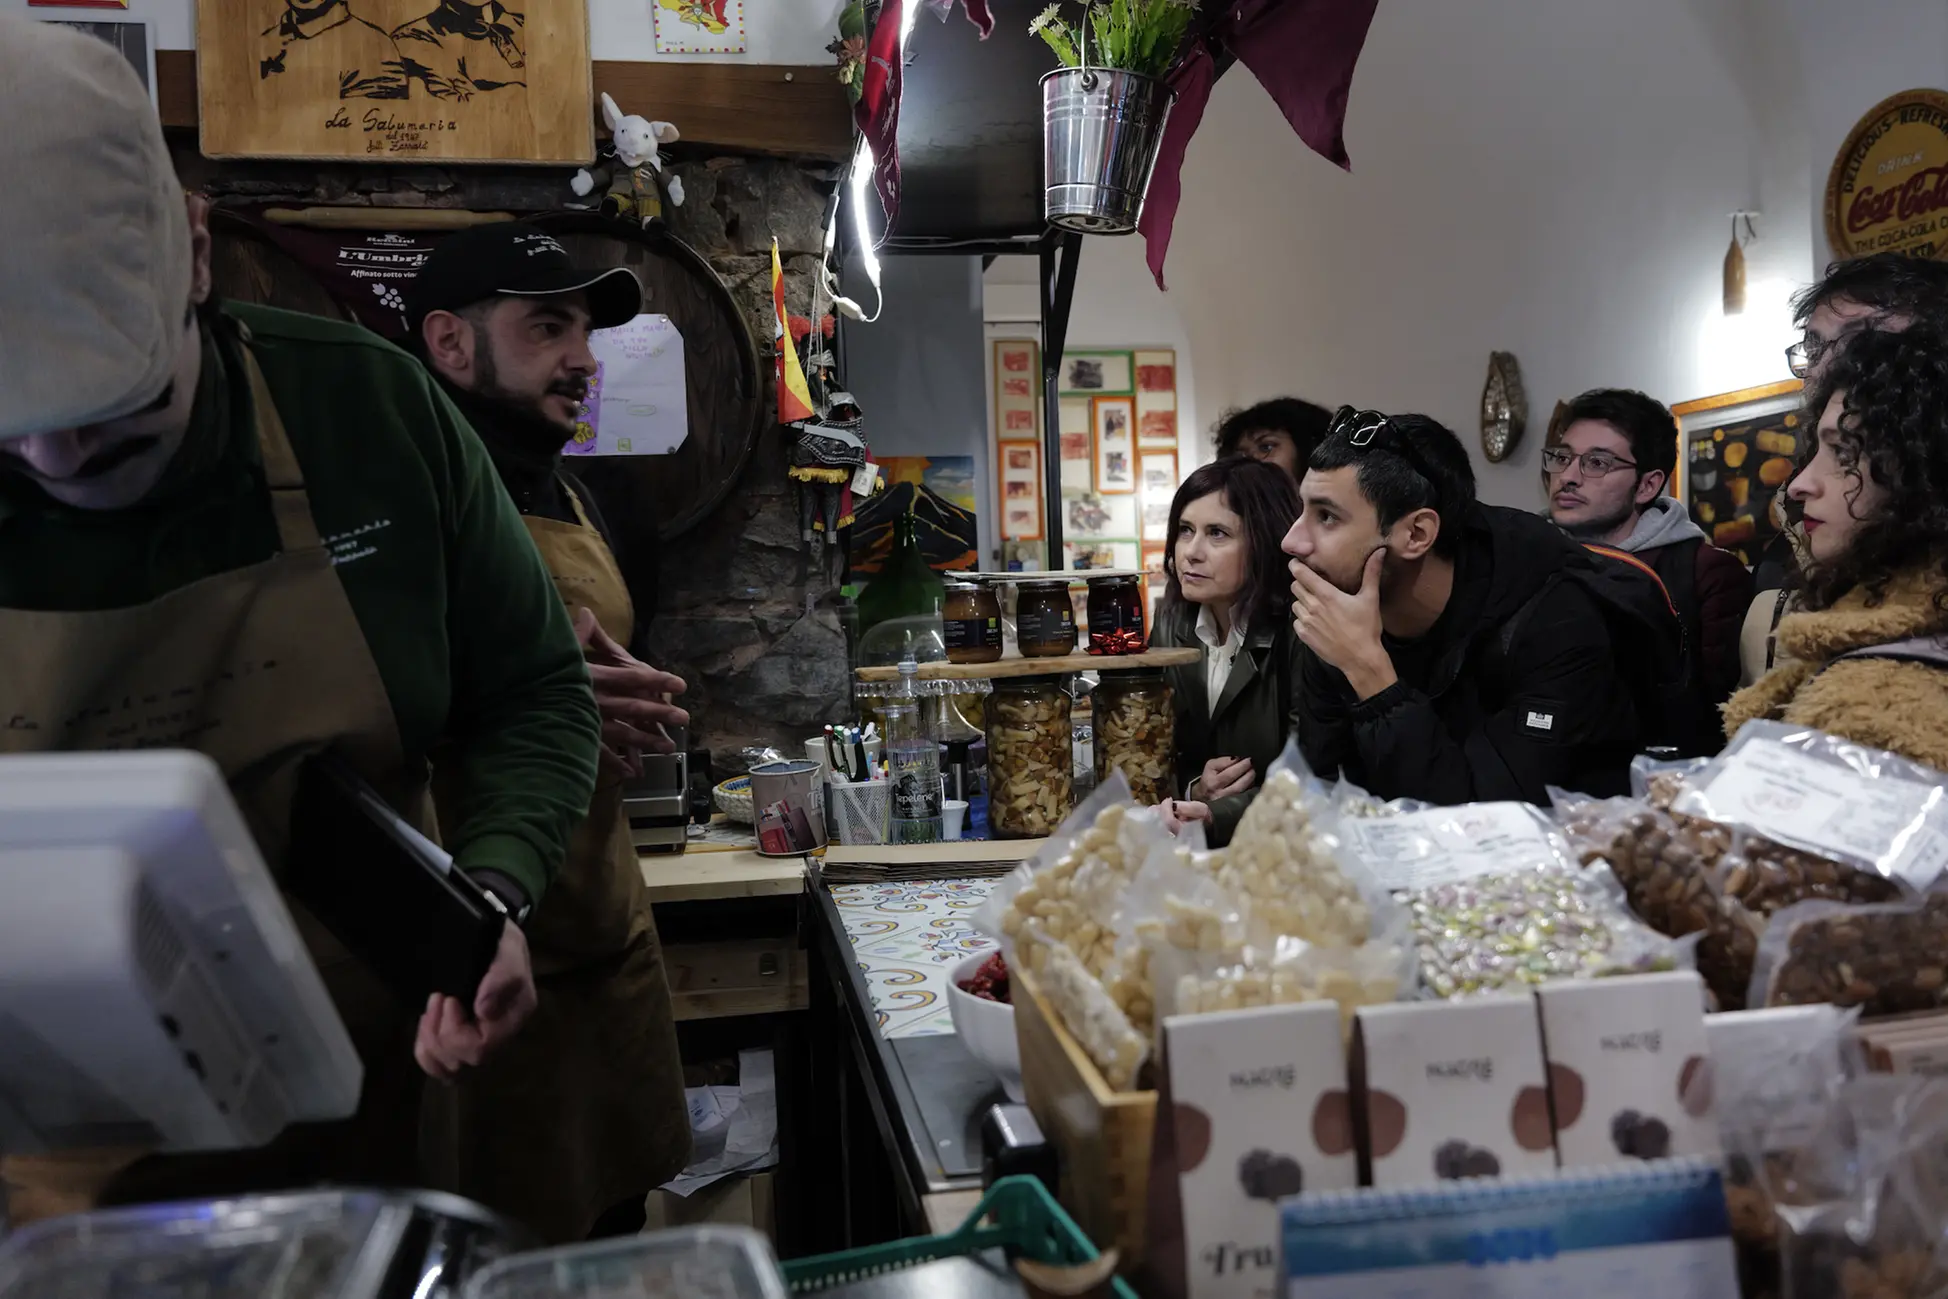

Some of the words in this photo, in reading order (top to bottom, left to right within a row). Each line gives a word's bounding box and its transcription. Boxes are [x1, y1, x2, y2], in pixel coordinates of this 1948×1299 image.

[325, 106, 352, 129] La
[1843, 118, 1893, 193] DELICIOUS
[1878, 149, 1924, 175] DRINK
[1847, 162, 1948, 233] Coca-Col
[1854, 238, 1876, 252] THE
[1878, 220, 1937, 247] COCA-COLA
[350, 269, 382, 279] Affinato
